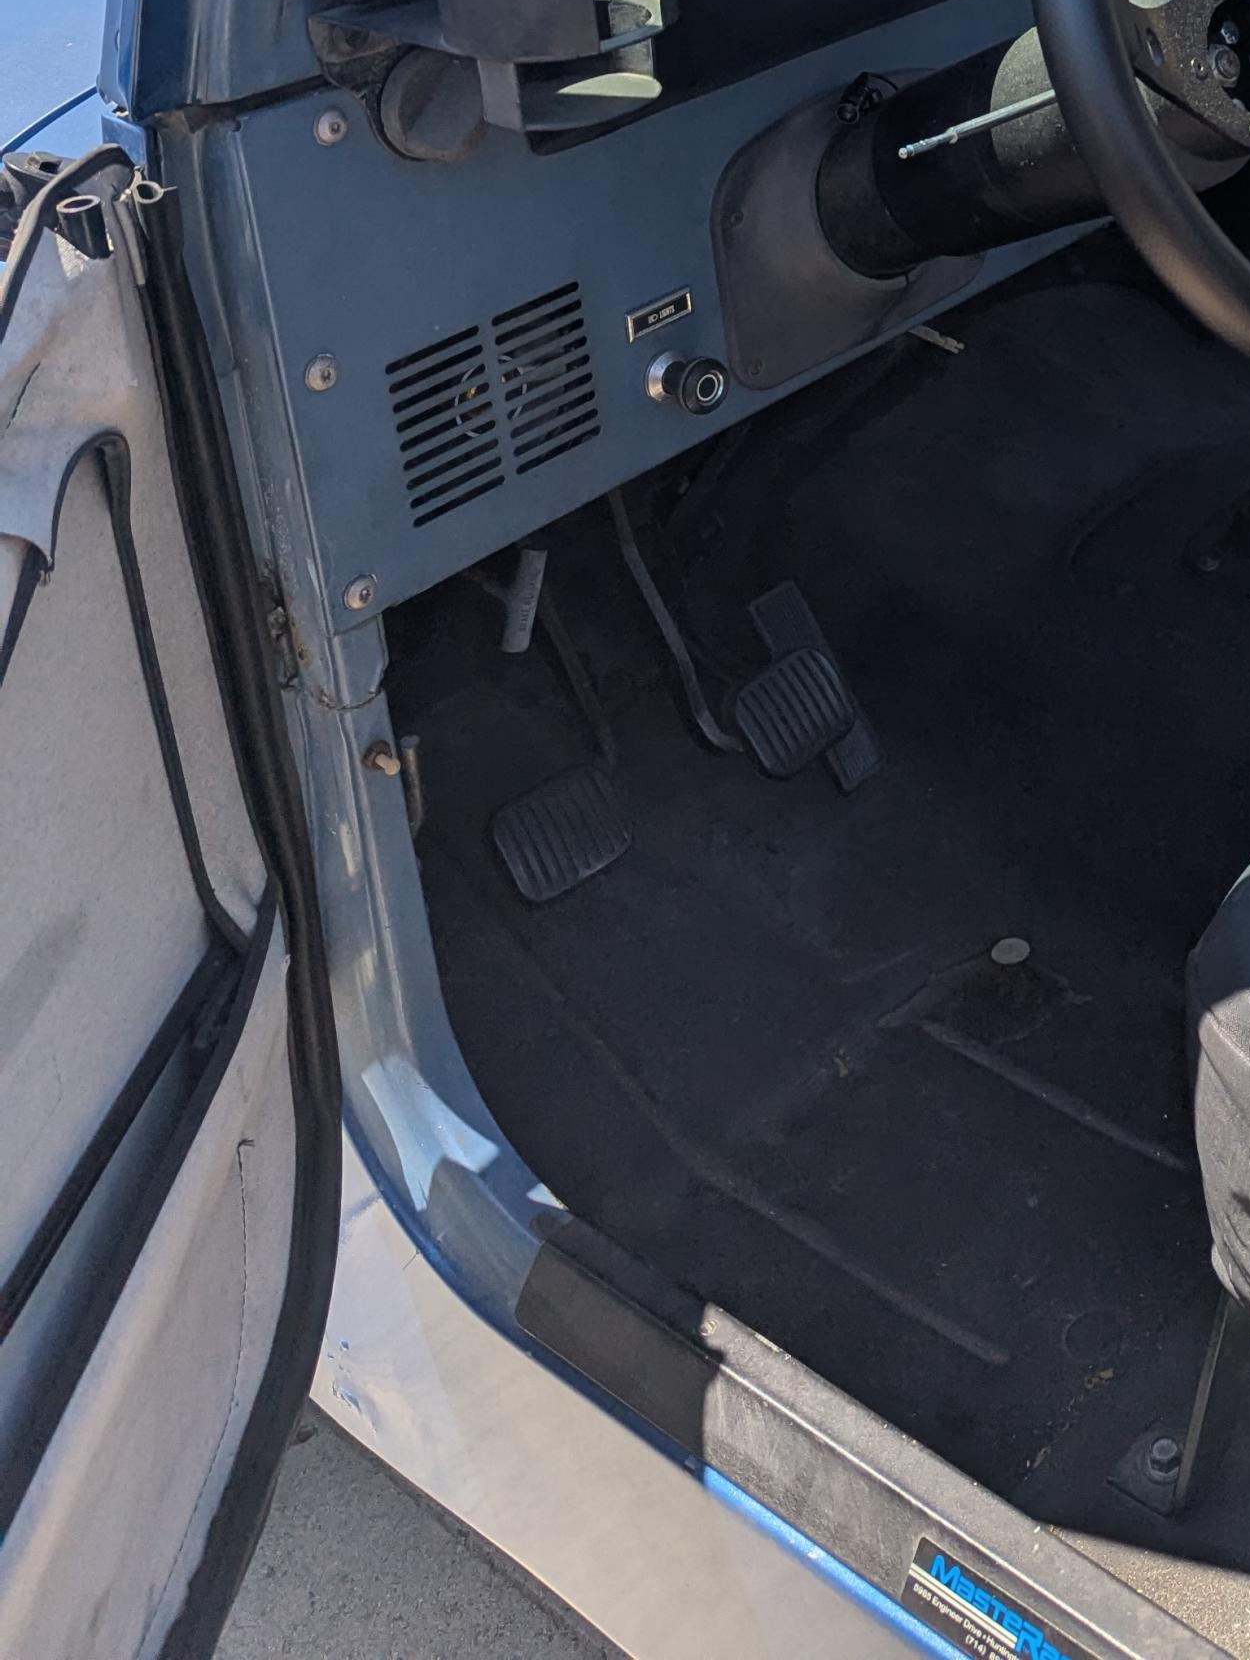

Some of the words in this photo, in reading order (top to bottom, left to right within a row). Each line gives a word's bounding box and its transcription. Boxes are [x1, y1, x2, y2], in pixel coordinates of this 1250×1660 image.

[931, 1596, 964, 1624] Engineer
[962, 1618, 982, 1638] Drive
[965, 1634, 986, 1655] (714)
